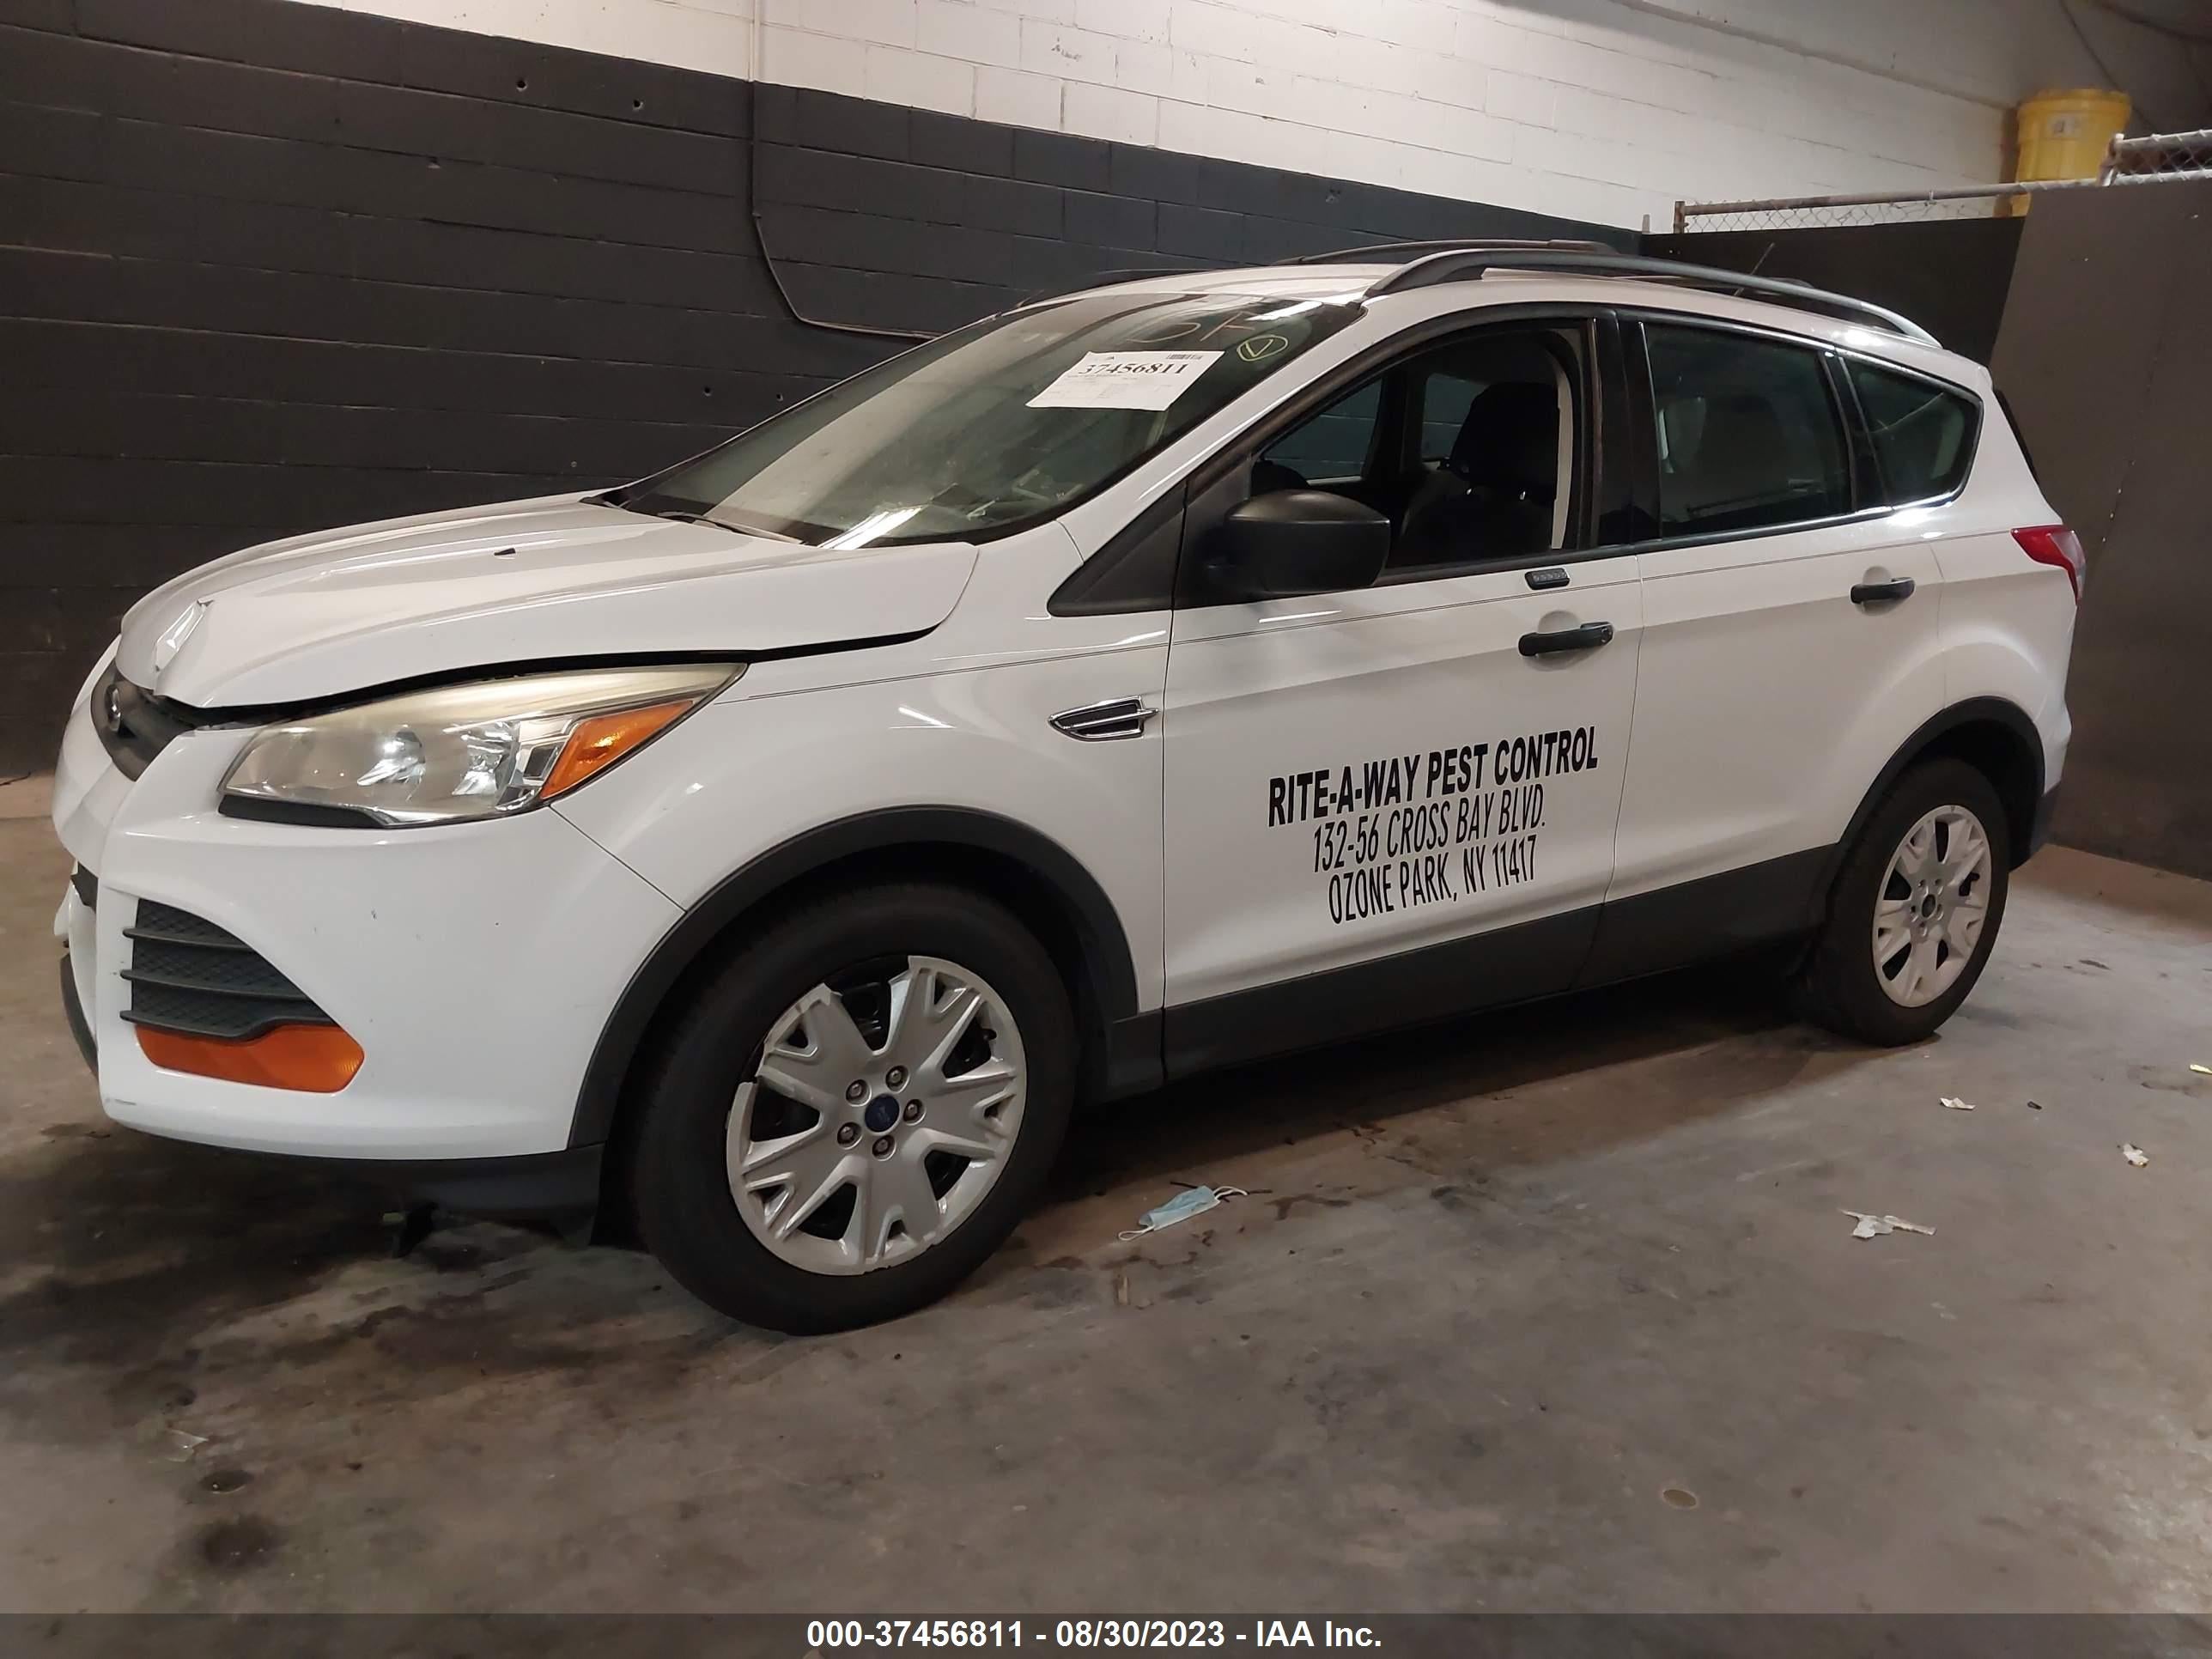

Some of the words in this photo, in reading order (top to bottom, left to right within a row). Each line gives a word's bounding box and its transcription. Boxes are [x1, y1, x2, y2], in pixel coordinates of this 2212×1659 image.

[1078, 362, 1190, 375] 37456811
[1268, 754, 1421, 828] RITE-A-WAY
[1425, 743, 1489, 799] PEST
[1494, 726, 1598, 786] CONTROL
[1314, 812, 1380, 873] 132-56
[1387, 800, 1451, 858] CROSS
[1455, 792, 1495, 844] BAY
[1498, 783, 1546, 836] BLVD.
[1328, 860, 1395, 925] OZONE
[1399, 851, 1458, 908] PARK,
[1463, 844, 1486, 895] NY
[1492, 834, 1537, 888] 11417
